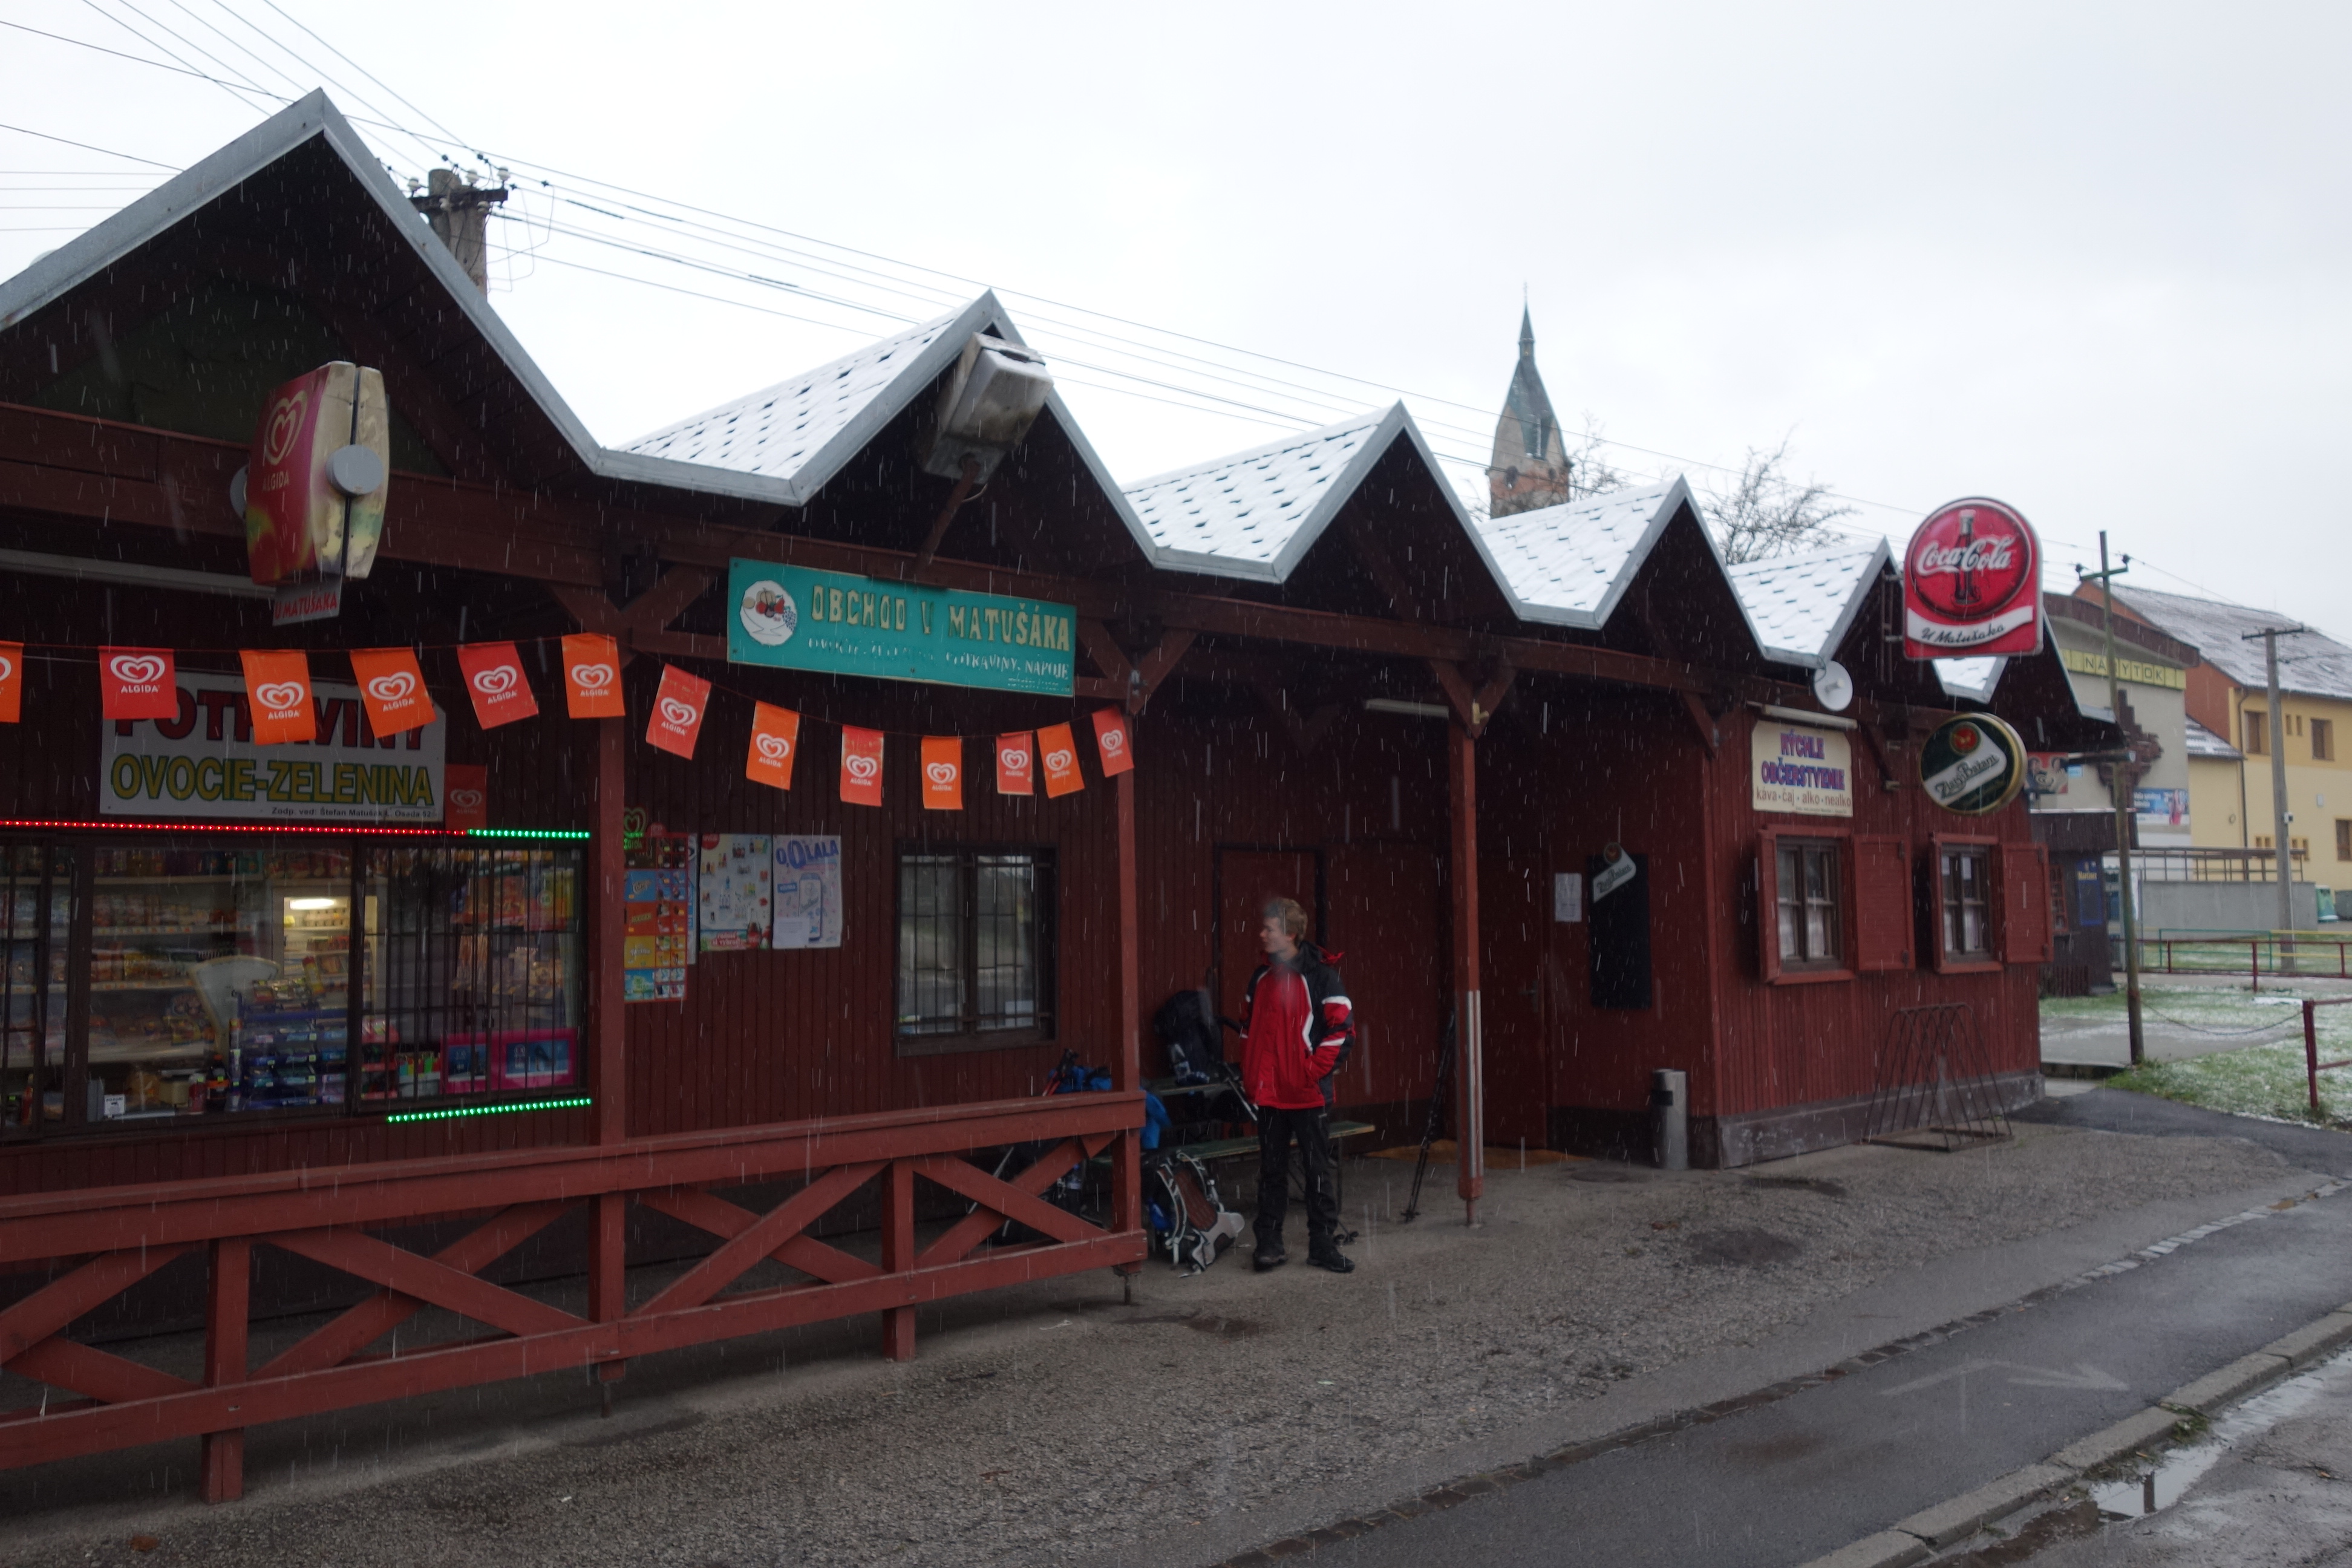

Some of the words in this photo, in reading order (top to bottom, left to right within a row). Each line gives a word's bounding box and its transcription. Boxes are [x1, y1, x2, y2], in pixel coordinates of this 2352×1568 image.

[262, 470, 289, 492] ALGIDA
[811, 584, 906, 630] OBCHOD
[948, 603, 1070, 652] MATUŠÁKA
[2085, 657, 2163, 681] NAYTOK
[121, 684, 159, 693] ALGIDA
[580, 688, 609, 697] ALGIDA
[383, 697, 415, 713] ALGIDA
[488, 690, 517, 705] ALGIDA
[268, 710, 299, 720] ALGIDA
[661, 720, 686, 736] ALGIDA
[1780, 728, 1825, 760] RÝCHLE
[758, 756, 782, 768] ALGIDA
[111, 753, 435, 806] OVOCIE-ZELENINA
[850, 777, 872, 786] ALGIDA
[1761, 756, 1846, 791] OBČERSTVENIE
[931, 783, 953, 792] ALGIDA
[1757, 786, 1777, 801] káva
[1782, 788, 1795, 806] čaj
[1802, 791, 1820, 805] alko
[1824, 794, 1851, 807] nealko
